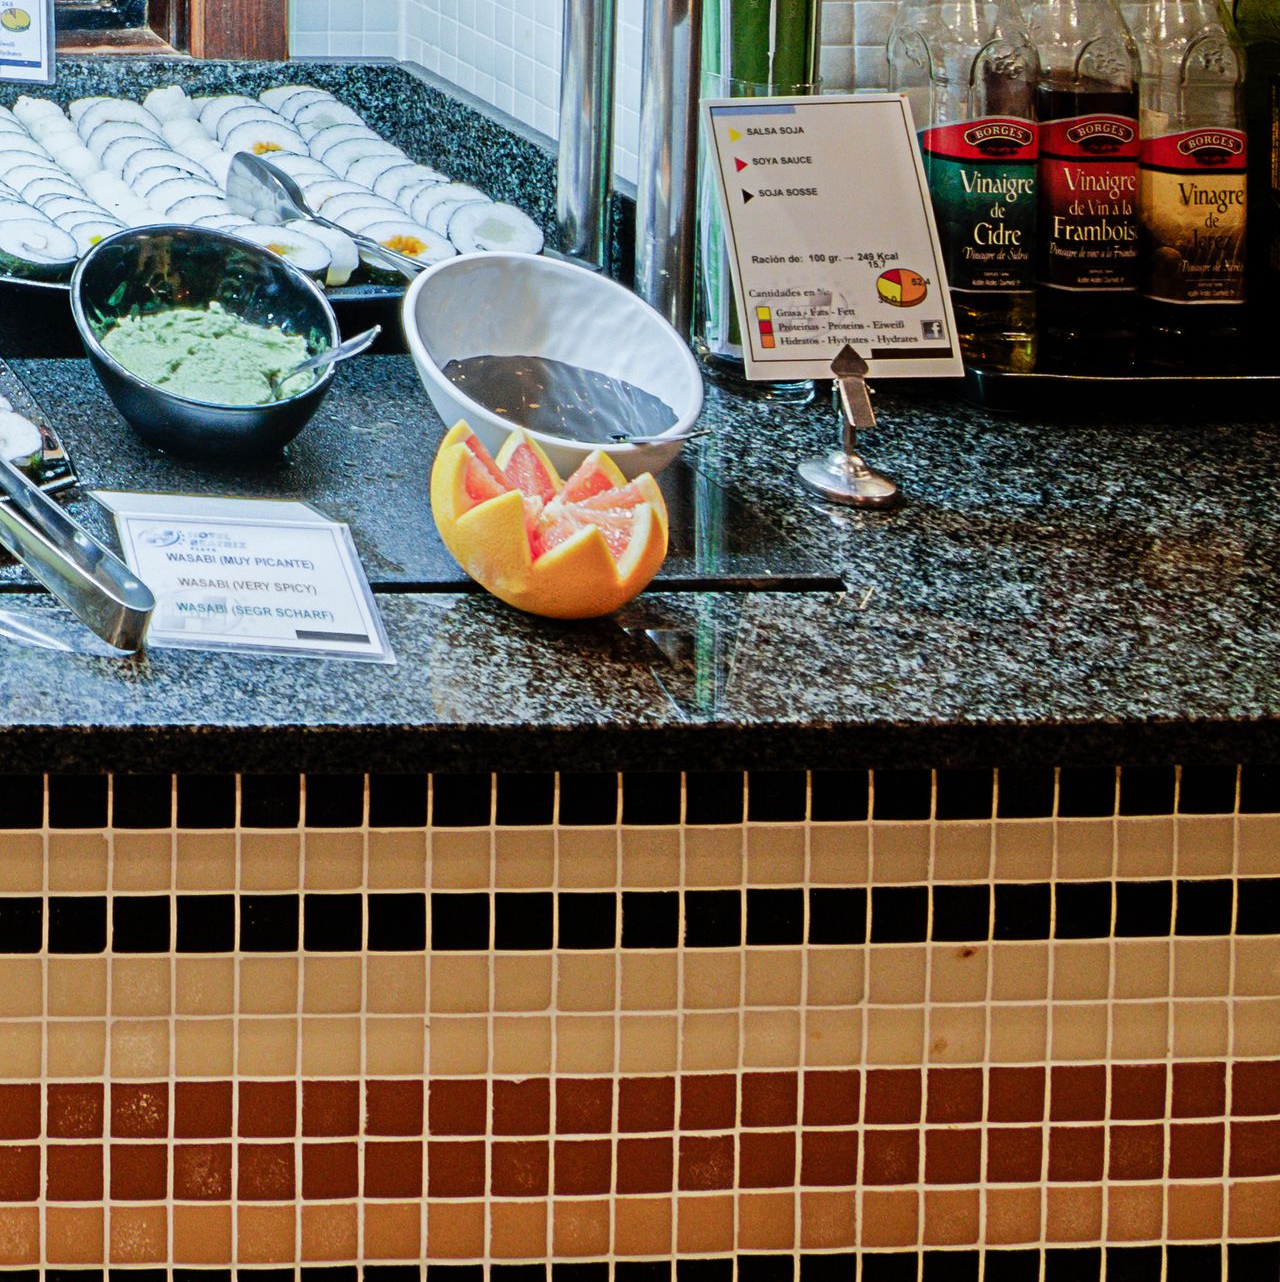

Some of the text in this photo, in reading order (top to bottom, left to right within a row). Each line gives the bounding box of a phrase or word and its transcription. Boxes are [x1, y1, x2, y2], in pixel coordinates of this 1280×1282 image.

[746, 127, 777, 135] SALSA
[975, 126, 1024, 139] BORGES
[1079, 123, 1124, 136] BORGES
[1188, 135, 1234, 148] BORGES
[752, 156, 812, 165] SOYA SAUCE
[960, 170, 1034, 202] Vinaigre
[1064, 168, 1136, 199] Vinaigre
[758, 188, 818, 197] SOJA SOSSE
[1179, 183, 1244, 213] Vinagre
[990, 202, 1005, 218] de
[1069, 200, 1084, 215] de
[1088, 199, 1109, 215] Vin
[1123, 199, 1132, 215] la
[1205, 212, 1219, 228] de
[974, 222, 1021, 245] Cidre
[752, 252, 899, 264] Ración de: 100 gr. 249 Kcal
[748, 288, 801, 299] Cantidades
[165, 552, 315, 571] WASABI (MUY PICANTE)
[178, 577, 317, 596] WASABI (VERY SPICY)
[175, 602, 228, 614] WASABI
[276, 608, 334, 622] SCHARF)
